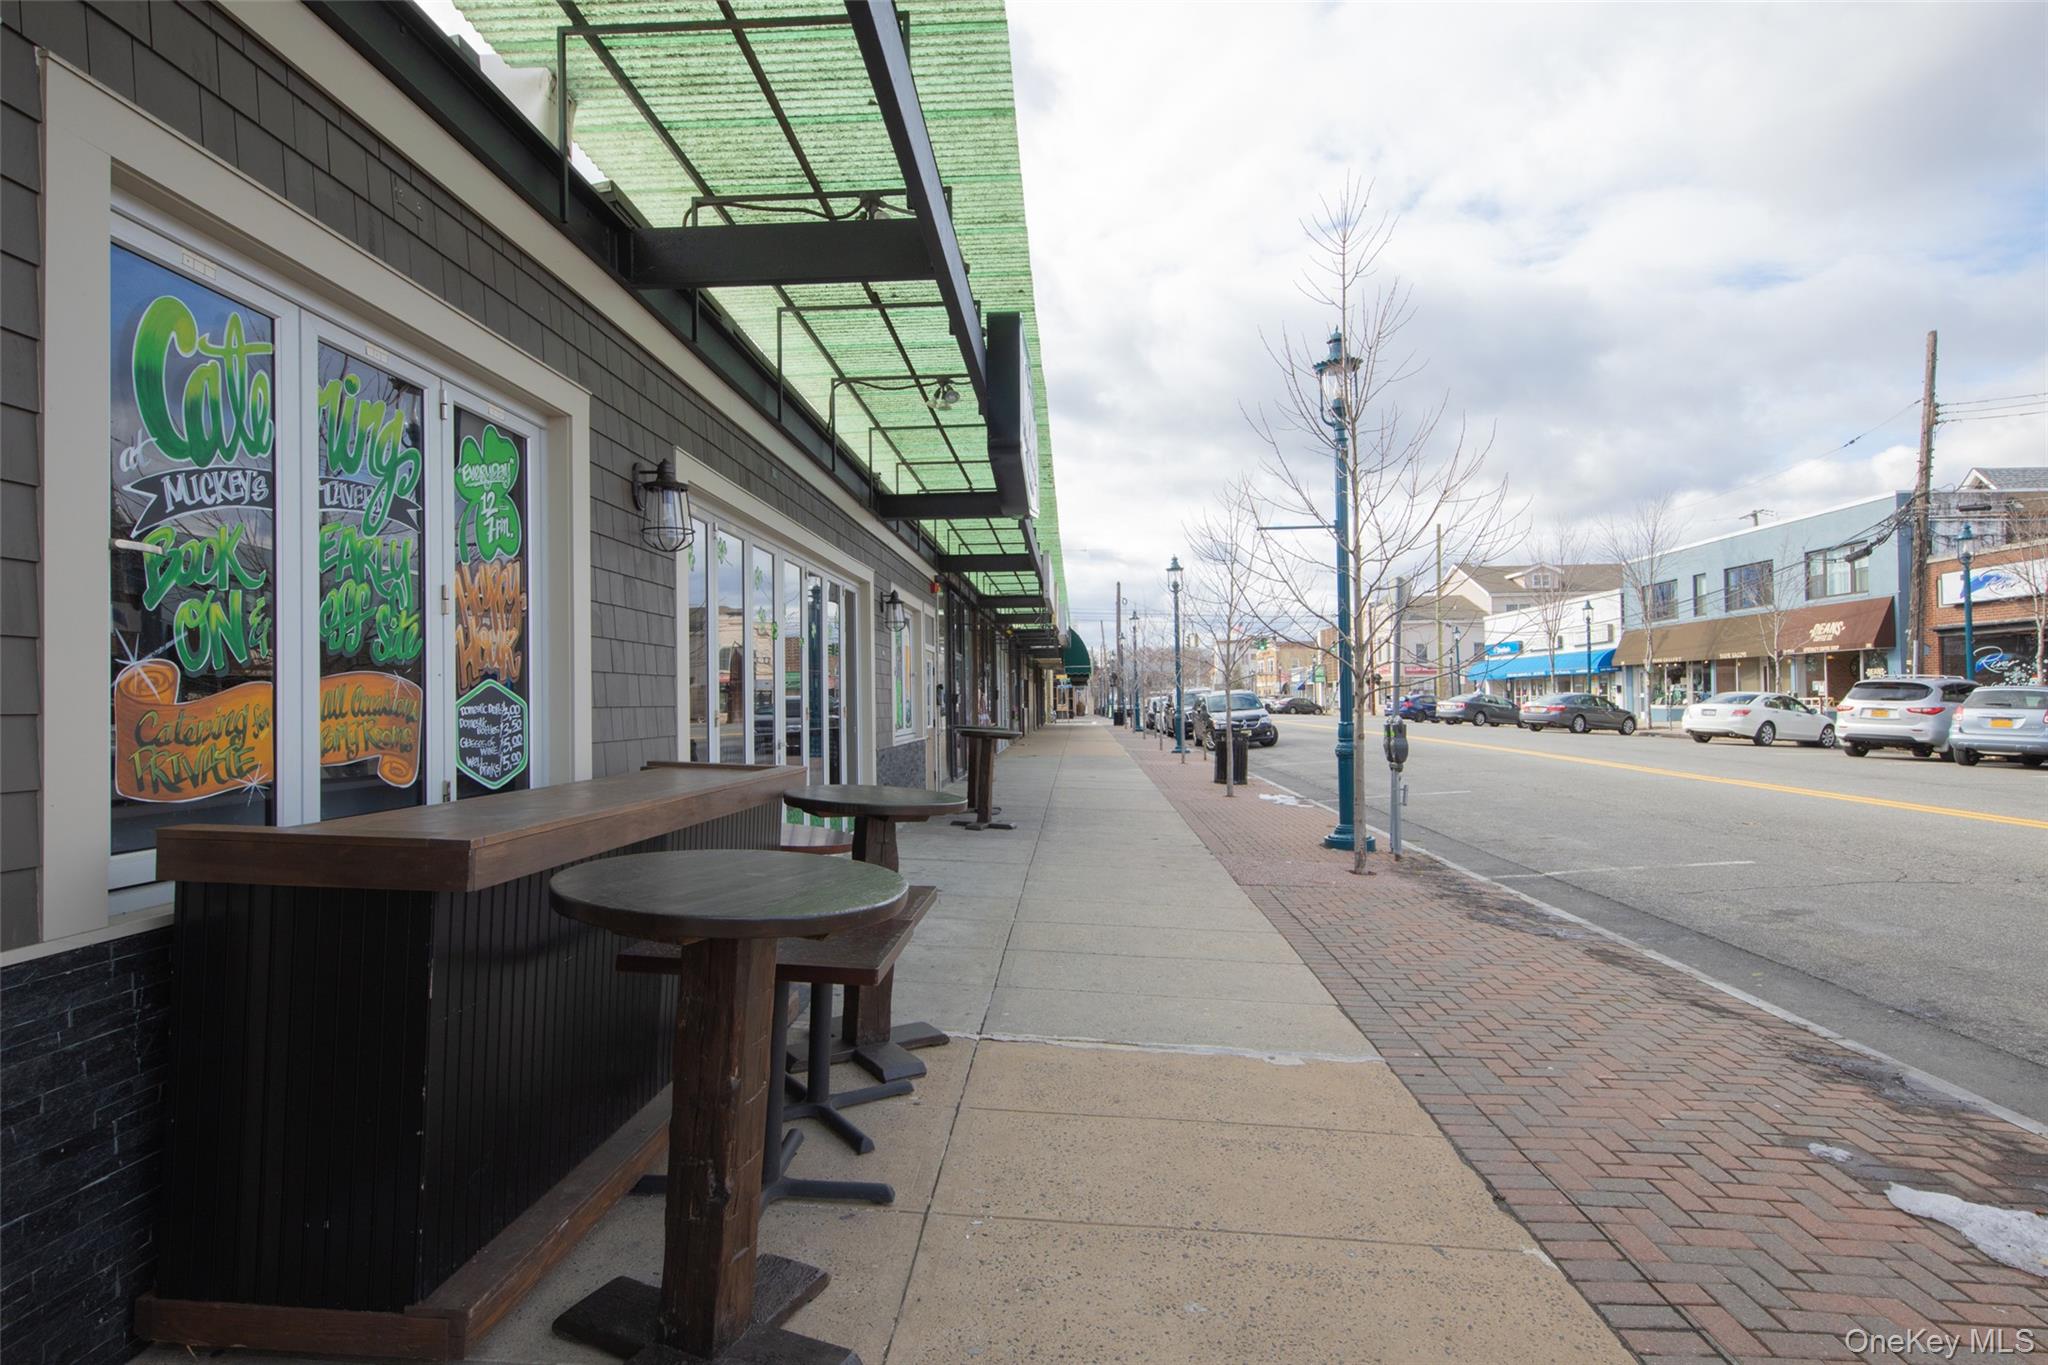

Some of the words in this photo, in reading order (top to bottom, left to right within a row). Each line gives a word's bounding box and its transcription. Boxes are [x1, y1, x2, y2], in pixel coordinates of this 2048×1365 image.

[119, 428, 157, 472] at
[480, 491, 499, 518] 12
[174, 590, 248, 671] ON
[135, 703, 249, 751] Catering
[128, 743, 262, 794] PRIVATE
